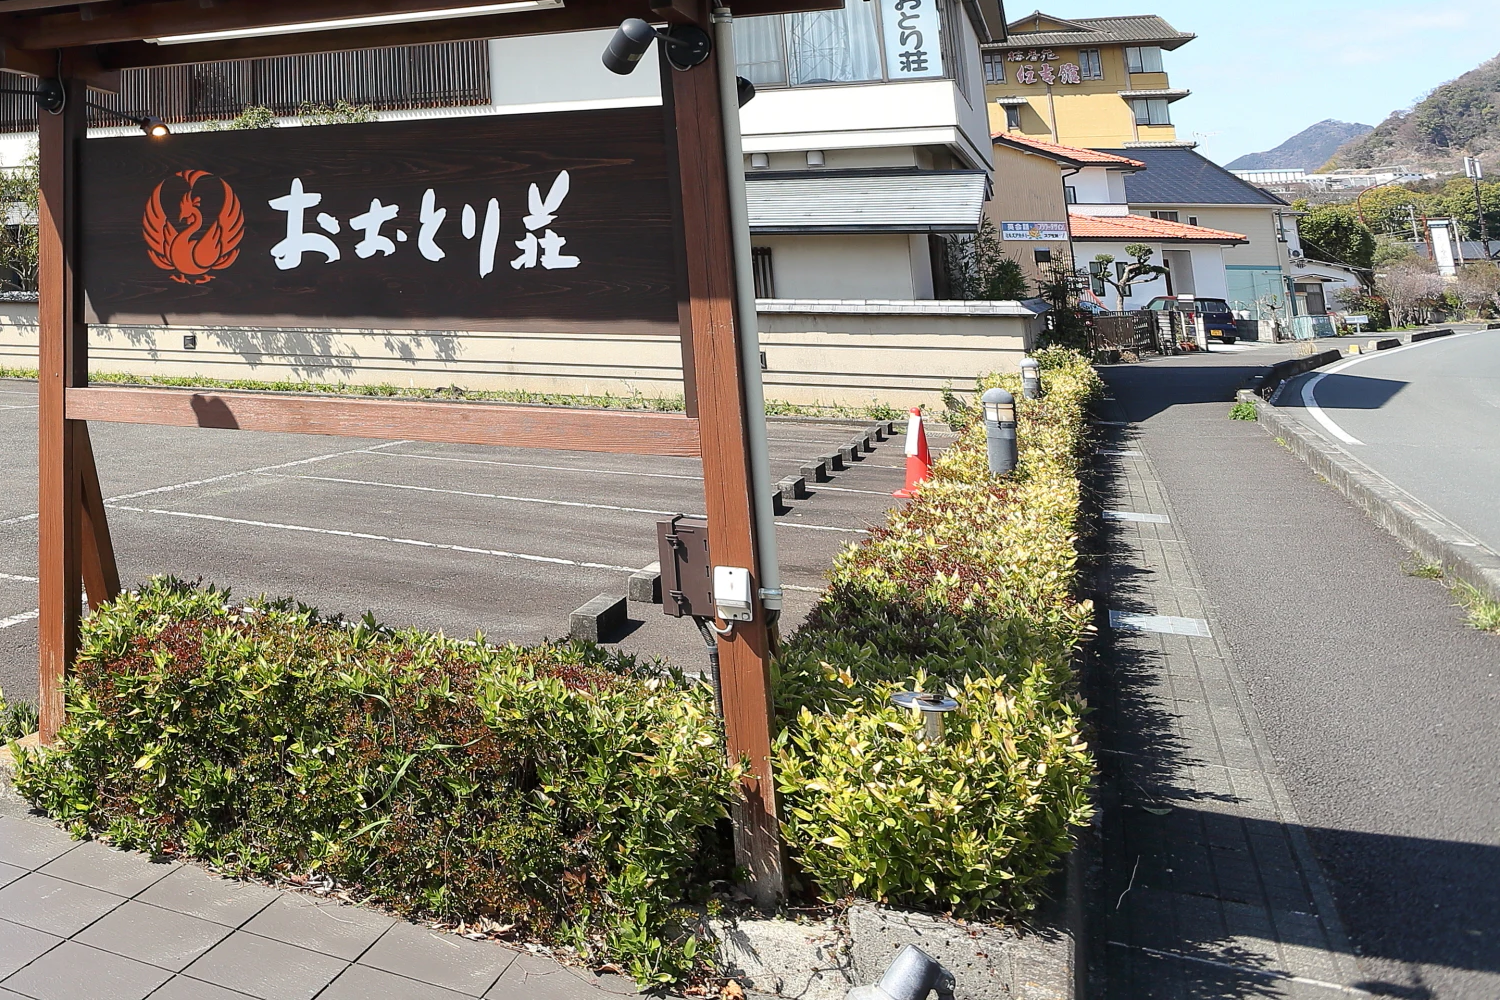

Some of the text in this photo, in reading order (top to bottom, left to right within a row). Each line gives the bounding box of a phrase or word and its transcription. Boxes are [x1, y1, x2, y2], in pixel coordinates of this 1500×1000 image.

[267, 170, 581, 279] おおとり荘
